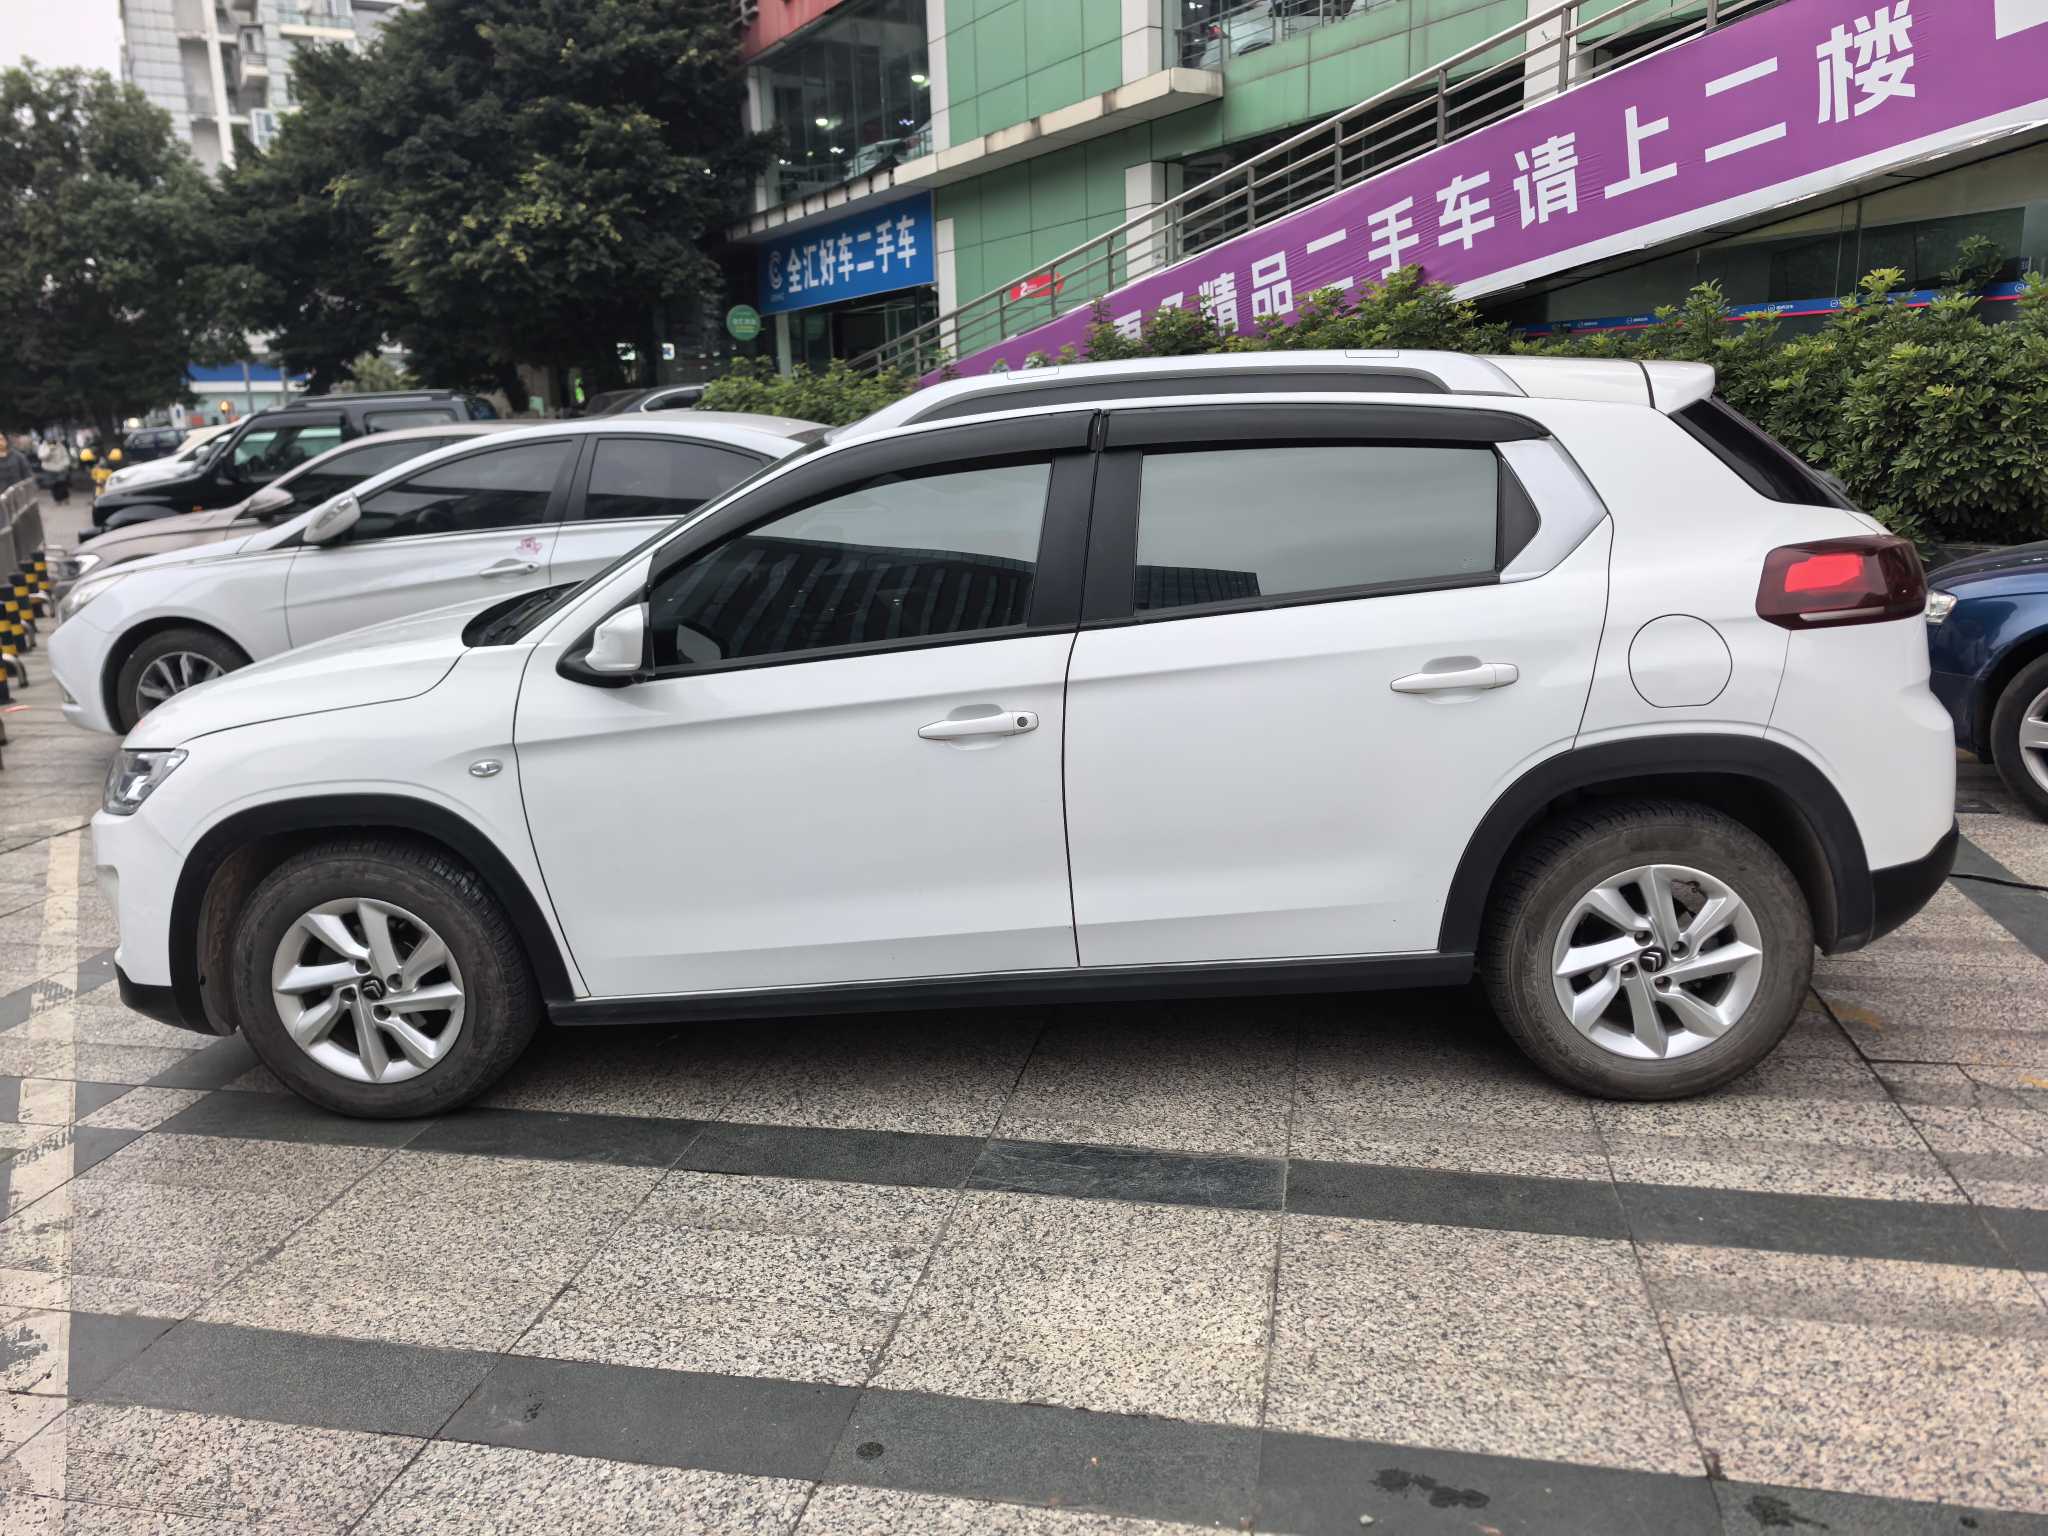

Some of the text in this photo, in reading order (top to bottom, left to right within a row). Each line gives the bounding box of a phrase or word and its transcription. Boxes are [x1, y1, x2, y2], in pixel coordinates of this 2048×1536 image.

[787, 214, 917, 294] 全汇好车二手车
[1113, 0, 1916, 341] 精品二手车请上二楼
